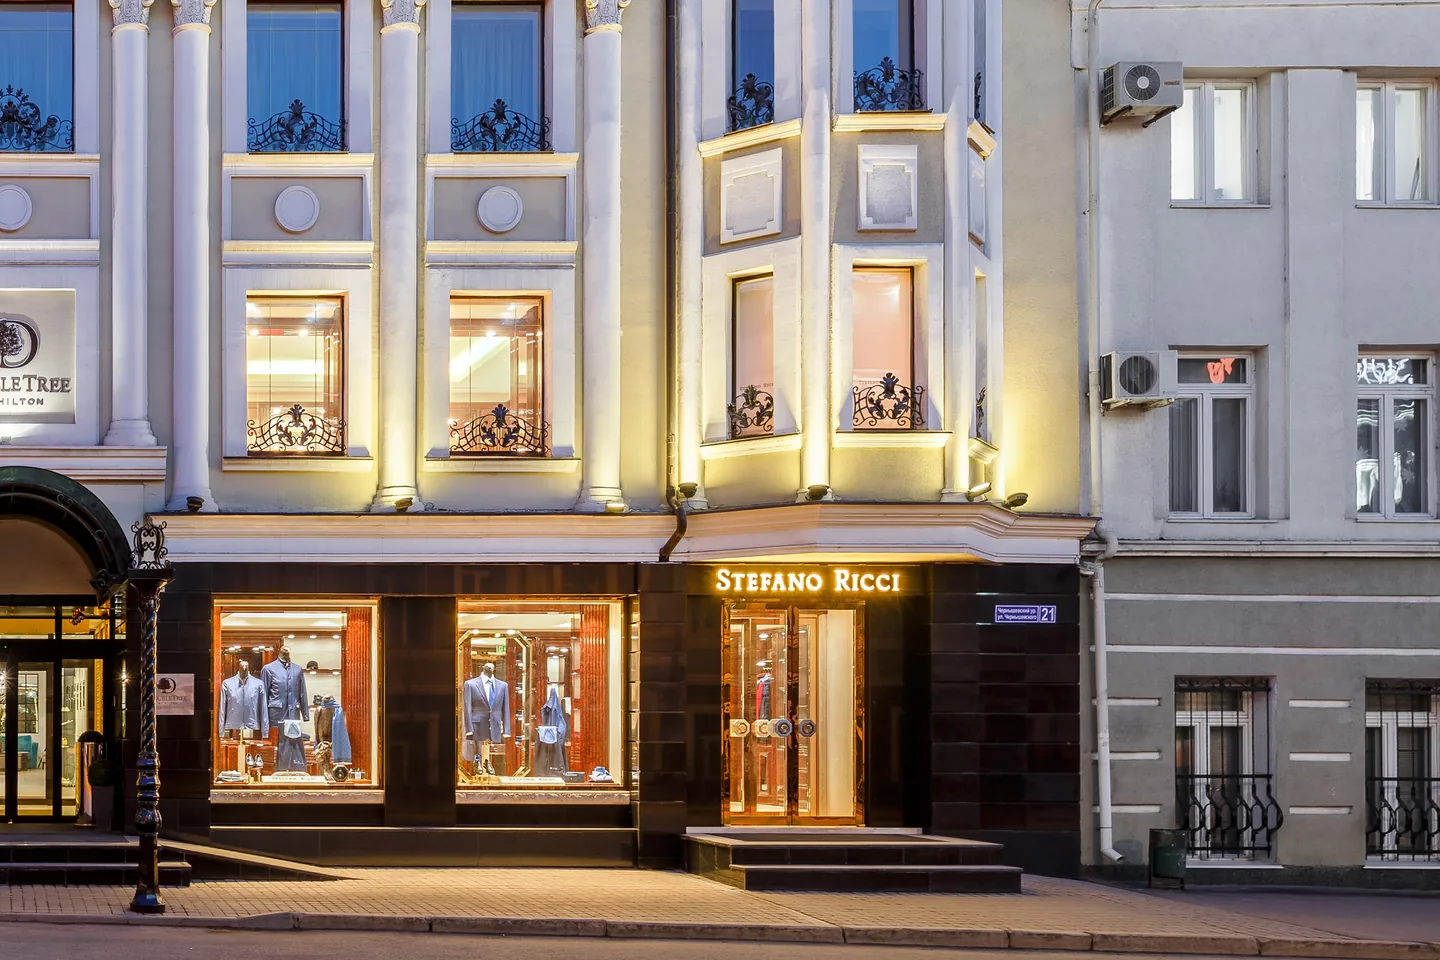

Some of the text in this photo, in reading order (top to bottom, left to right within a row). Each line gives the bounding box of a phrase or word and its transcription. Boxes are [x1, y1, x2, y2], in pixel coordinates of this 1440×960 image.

[716, 568, 901, 592] STEFANO RICCI
[1041, 607, 1054, 621] 21
